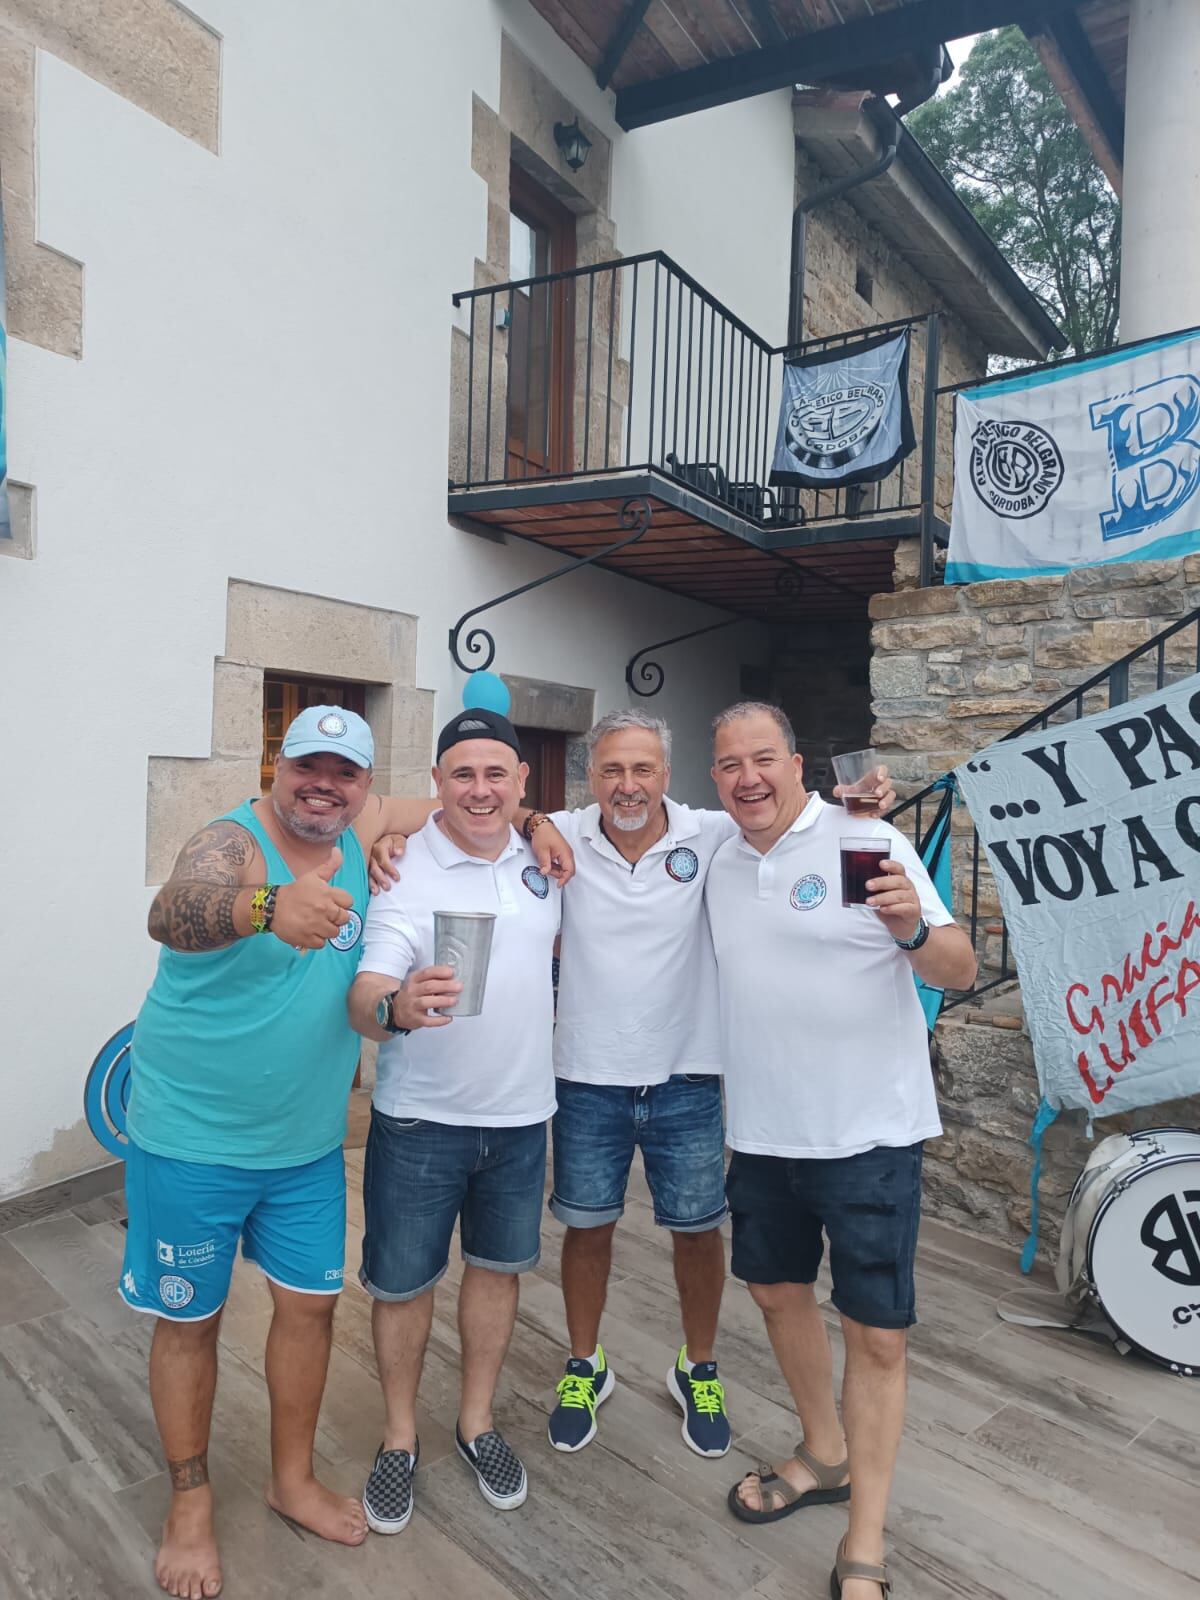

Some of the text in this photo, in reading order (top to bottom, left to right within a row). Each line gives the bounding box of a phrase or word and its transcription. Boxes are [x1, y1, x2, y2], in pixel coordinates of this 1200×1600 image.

[1021, 429, 1057, 496] BELGRANO
[1096, 690, 1200, 790] PA
[988, 823, 1120, 906] VOY
[1122, 815, 1185, 889] A
[178, 1243, 216, 1257] Lotería
